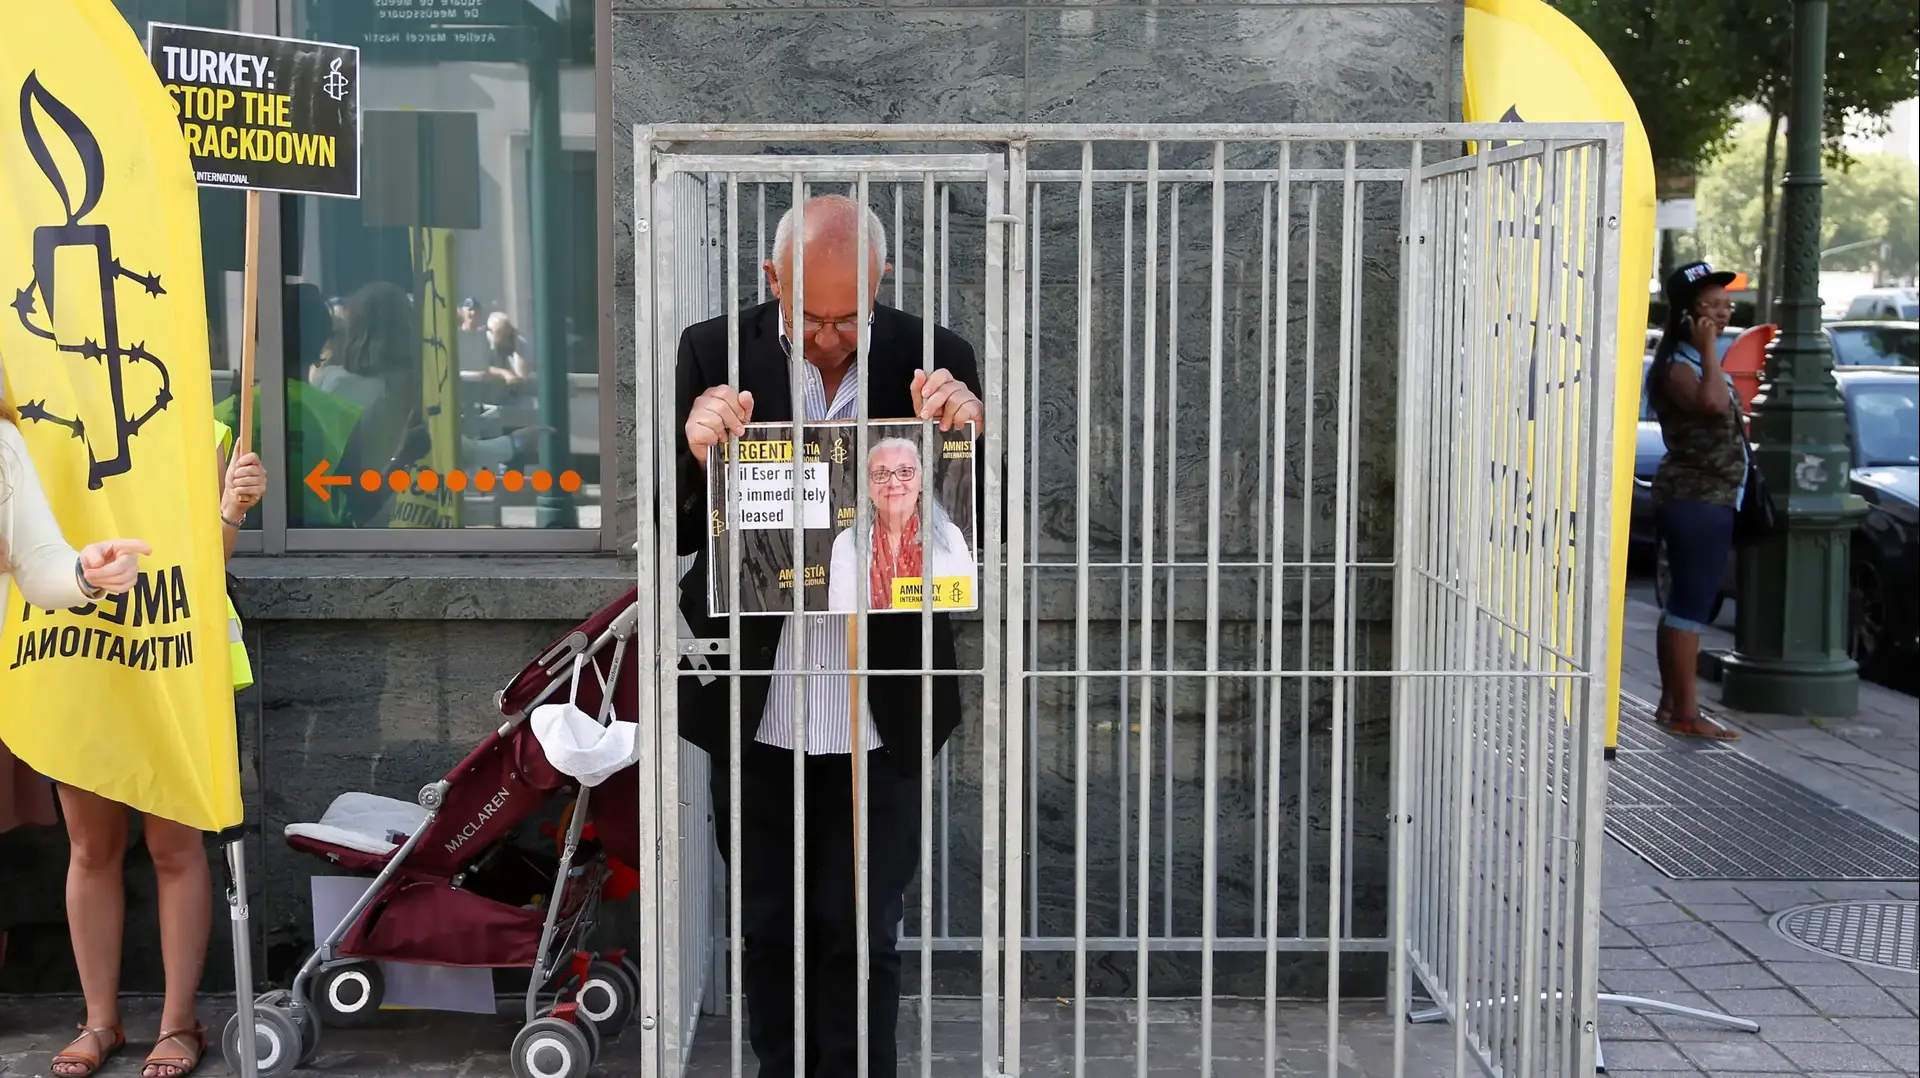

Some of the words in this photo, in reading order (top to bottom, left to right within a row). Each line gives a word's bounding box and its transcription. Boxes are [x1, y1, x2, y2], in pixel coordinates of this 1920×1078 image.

[163, 46, 275, 89] TURKEY:
[241, 91, 292, 128] THE
[184, 123, 336, 168] RACKDOWN
[196, 171, 250, 184] INTERNATIONAL
[727, 443, 787, 460] RGENT
[752, 467, 780, 480] Eser
[785, 467, 815, 480] mst
[747, 488, 826, 504] immeditely
[727, 509, 784, 522] leased
[778, 564, 826, 580] AMSTÍA
[900, 584, 942, 595] AMNTY
[444, 786, 510, 853] MACLAREN
